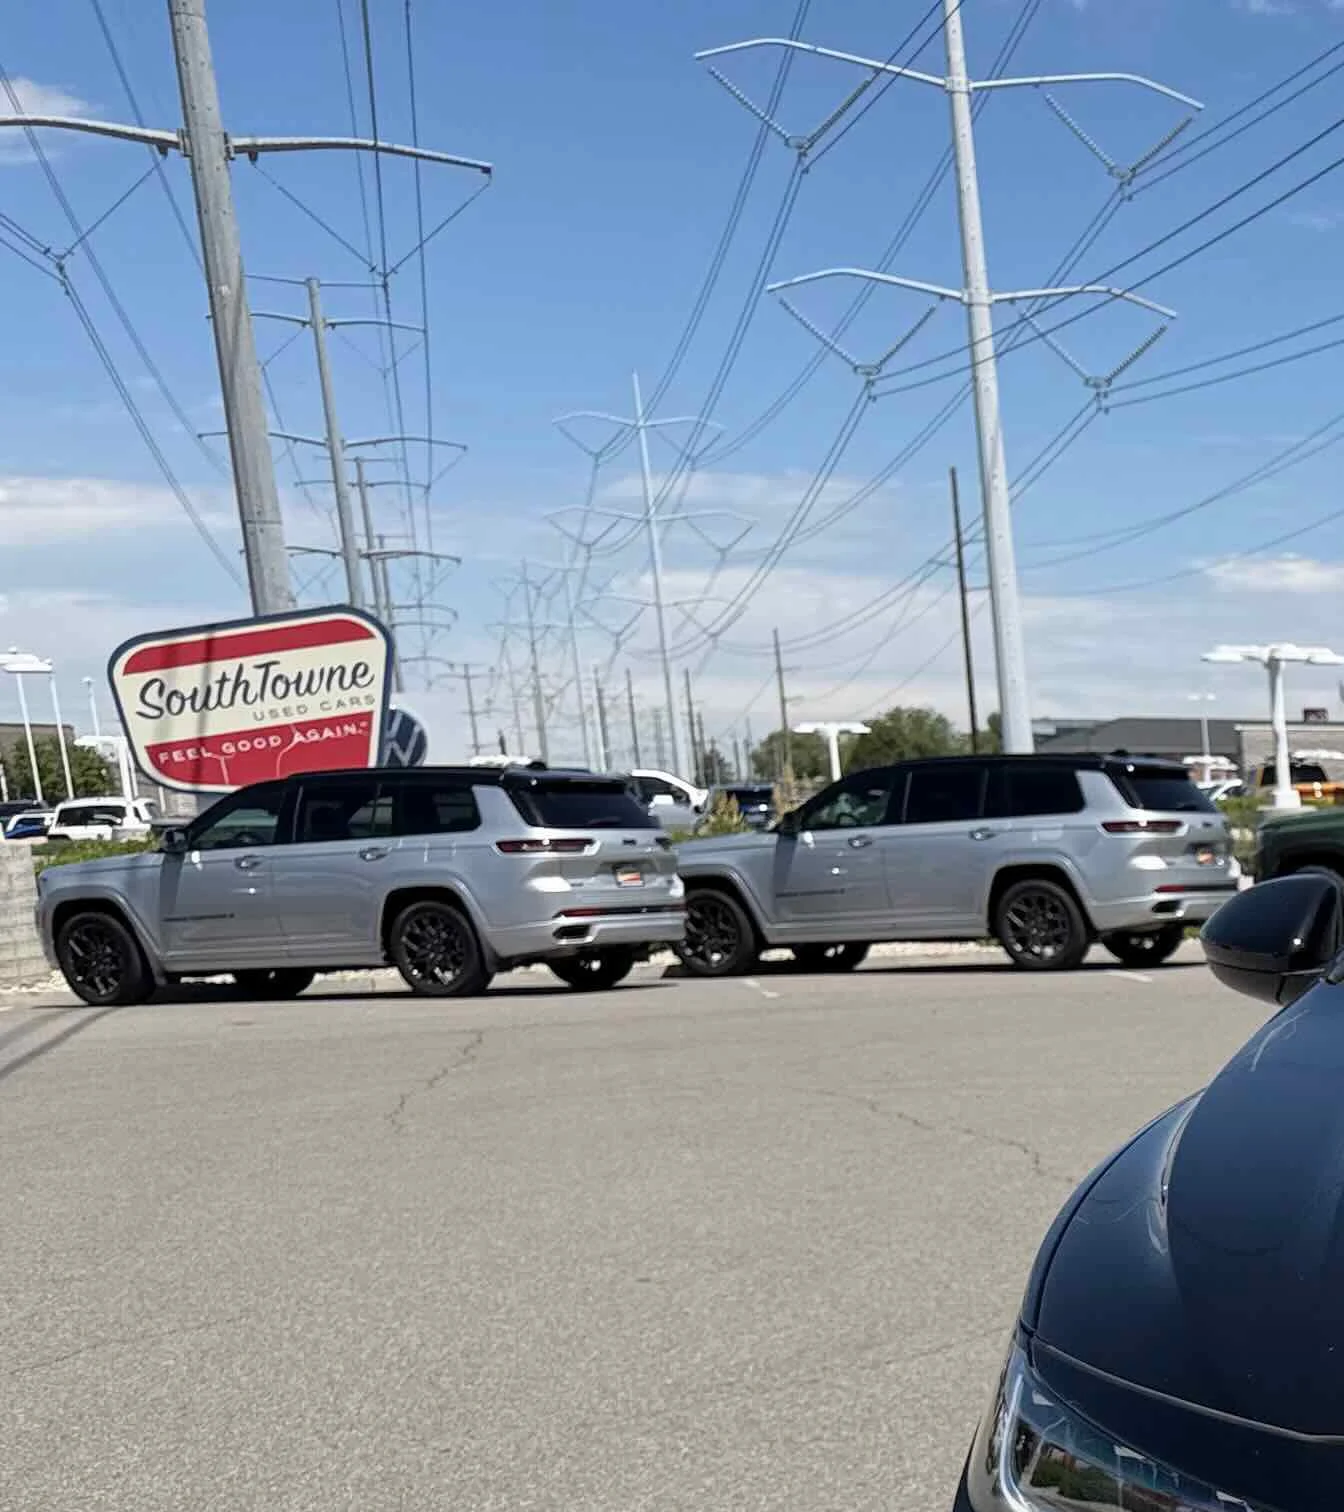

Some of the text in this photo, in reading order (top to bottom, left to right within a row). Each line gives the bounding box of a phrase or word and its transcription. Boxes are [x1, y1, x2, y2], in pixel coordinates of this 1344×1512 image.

[136, 660, 375, 720] SouthTowne
[253, 694, 375, 721] USED CARS
[158, 747, 211, 764] FEEL
[221, 735, 281, 754] GOOD
